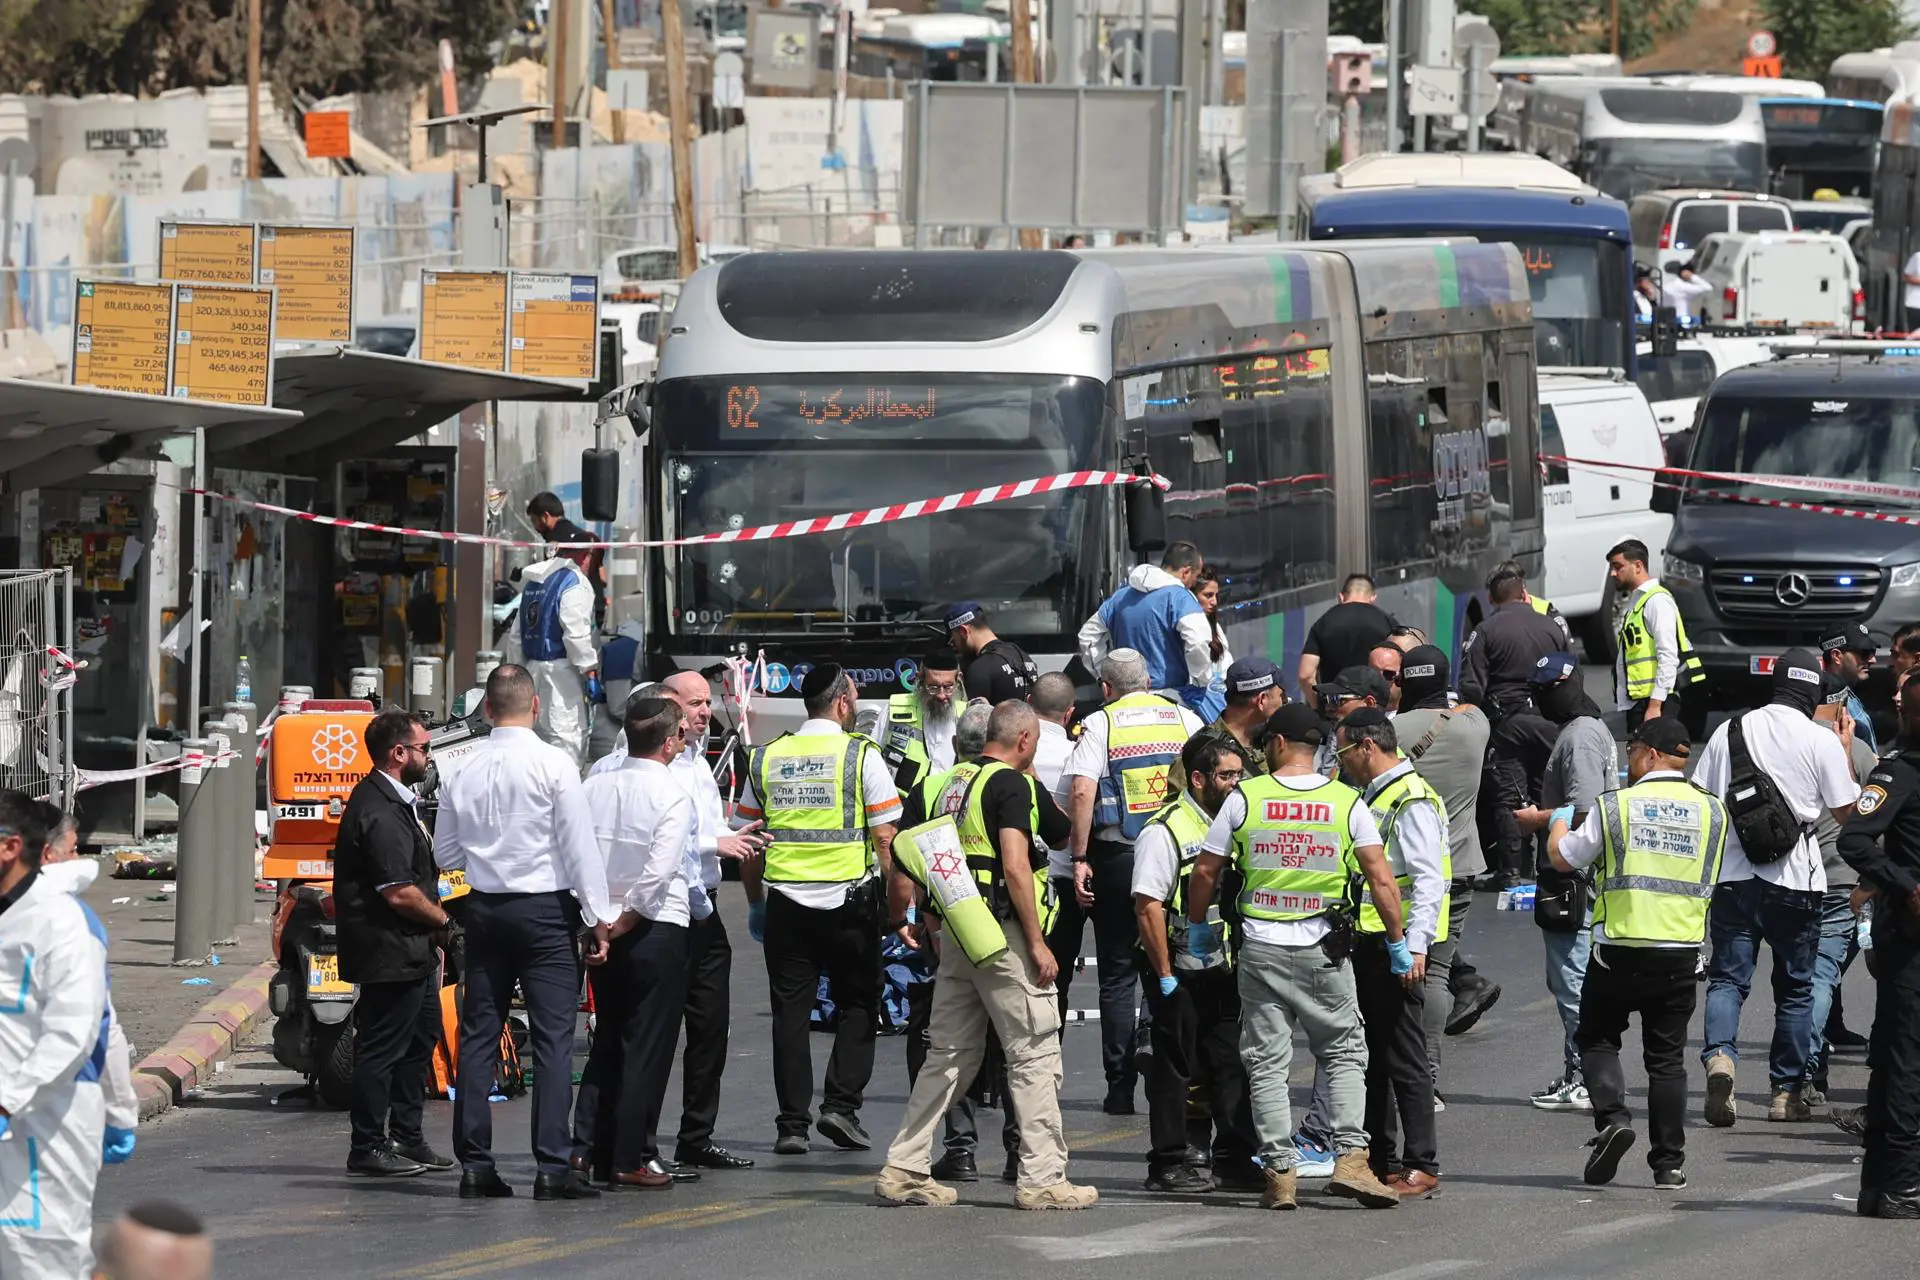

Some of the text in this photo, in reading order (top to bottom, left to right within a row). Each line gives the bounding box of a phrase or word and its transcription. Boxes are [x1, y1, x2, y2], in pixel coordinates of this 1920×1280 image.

[333, 246, 349, 255] 580
[338, 287, 349, 297] 36
[256, 296, 269, 304] 318
[337, 302, 348, 310] 46
[195, 306, 268, 318] 320,328,330,338
[230, 322, 267, 332] 340,348
[153, 332, 168, 341] 105
[240, 337, 267, 346] 121,122
[201, 348, 266, 361] 123,129,145,345
[208, 363, 266, 375] 465,469,475
[247, 379, 265, 388] 479
[727, 385, 760, 428] 62
[1405, 664, 1433, 676] POLICE
[1790, 669, 1819, 682] משטרה
[447, 744, 473, 760] הצלה
[293, 771, 332, 783] הצלה
[294, 785, 327, 793] UNITED
[797, 787, 826, 795] מתנדב
[773, 796, 831, 806] משטרת ישראל
[280, 807, 316, 818] 1491
[1266, 802, 1330, 822] חובש
[1278, 831, 1313, 844] הצלה
[1662, 831, 1691, 844] מתנדב
[1254, 843, 1335, 858] ללא גבולות
[1634, 835, 1694, 854] משטרת ישראל
[1281, 855, 1308, 868] SSF
[1254, 892, 1321, 912] מגן דוד אדום
[324, 972, 339, 983] 80
